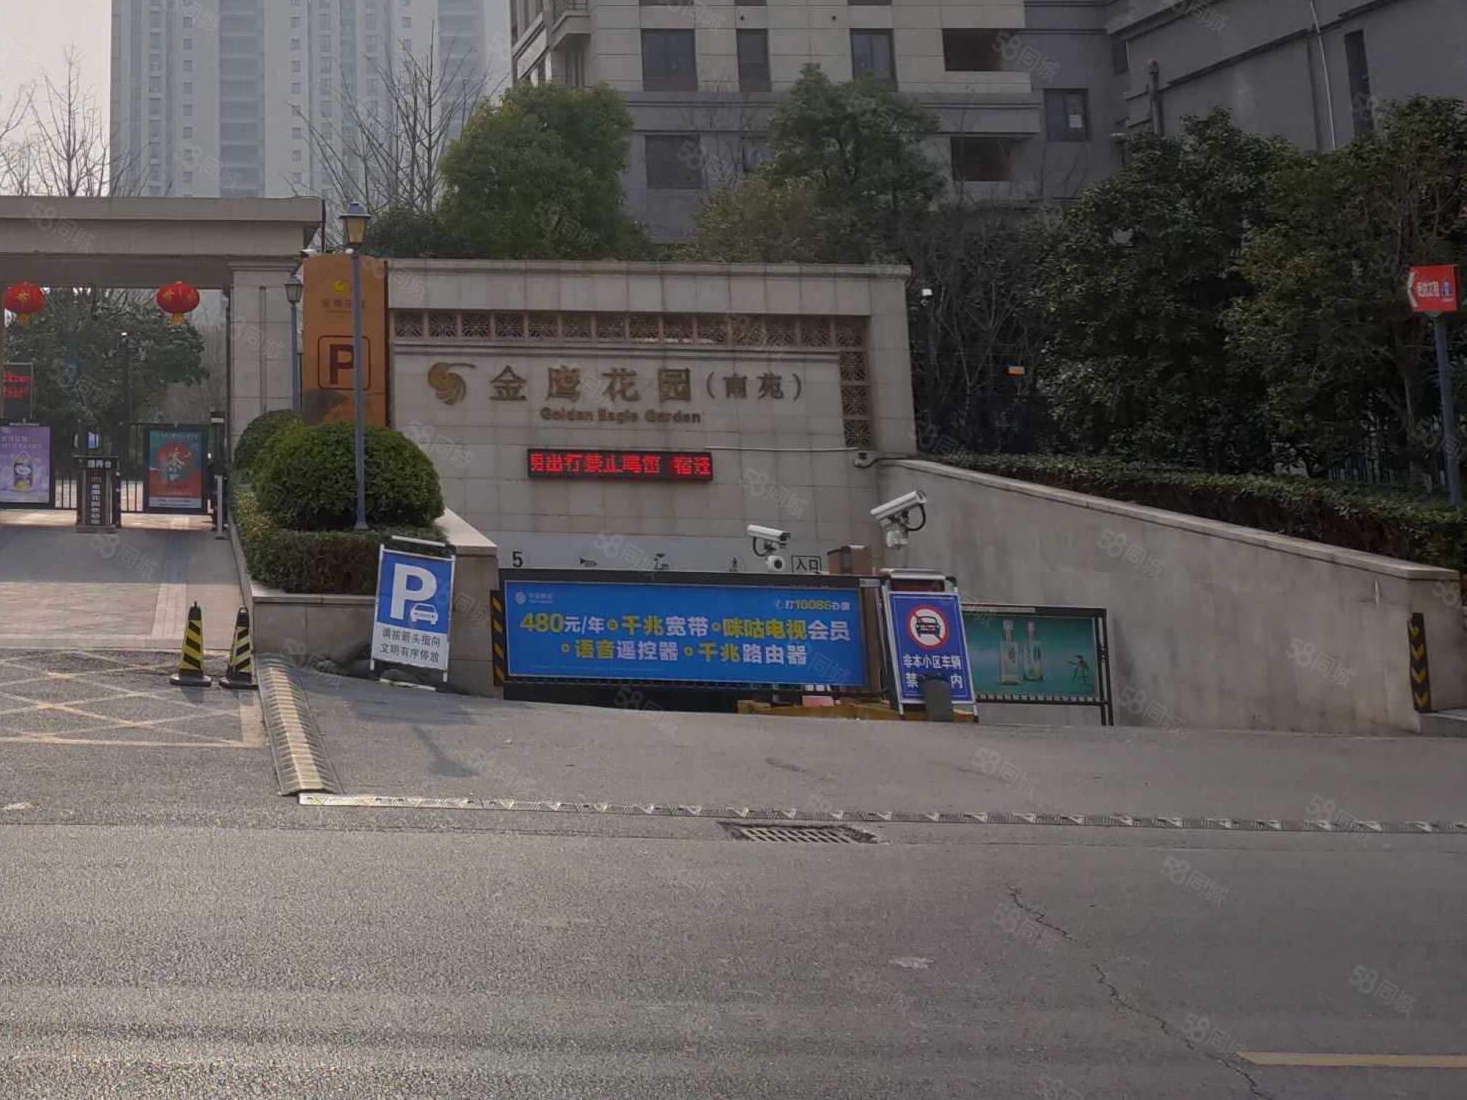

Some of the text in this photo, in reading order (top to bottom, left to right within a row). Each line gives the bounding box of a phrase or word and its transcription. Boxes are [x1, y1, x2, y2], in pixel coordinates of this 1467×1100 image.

[540, 407, 702, 425] Golden Eagle Garden
[512, 551, 523, 567] 5
[795, 557, 820, 572] 入口
[390, 563, 437, 620] P
[382, 626, 441, 648] 请按箭头指向
[519, 612, 851, 642] 480元/年 千兆宽带 咪咕电视会员
[380, 642, 440, 663] 文明有序停放
[575, 638, 807, 666] 语音遥控器 千兆路由器
[903, 653, 962, 670] 非本小区车辆
[905, 671, 964, 690] 禁内
